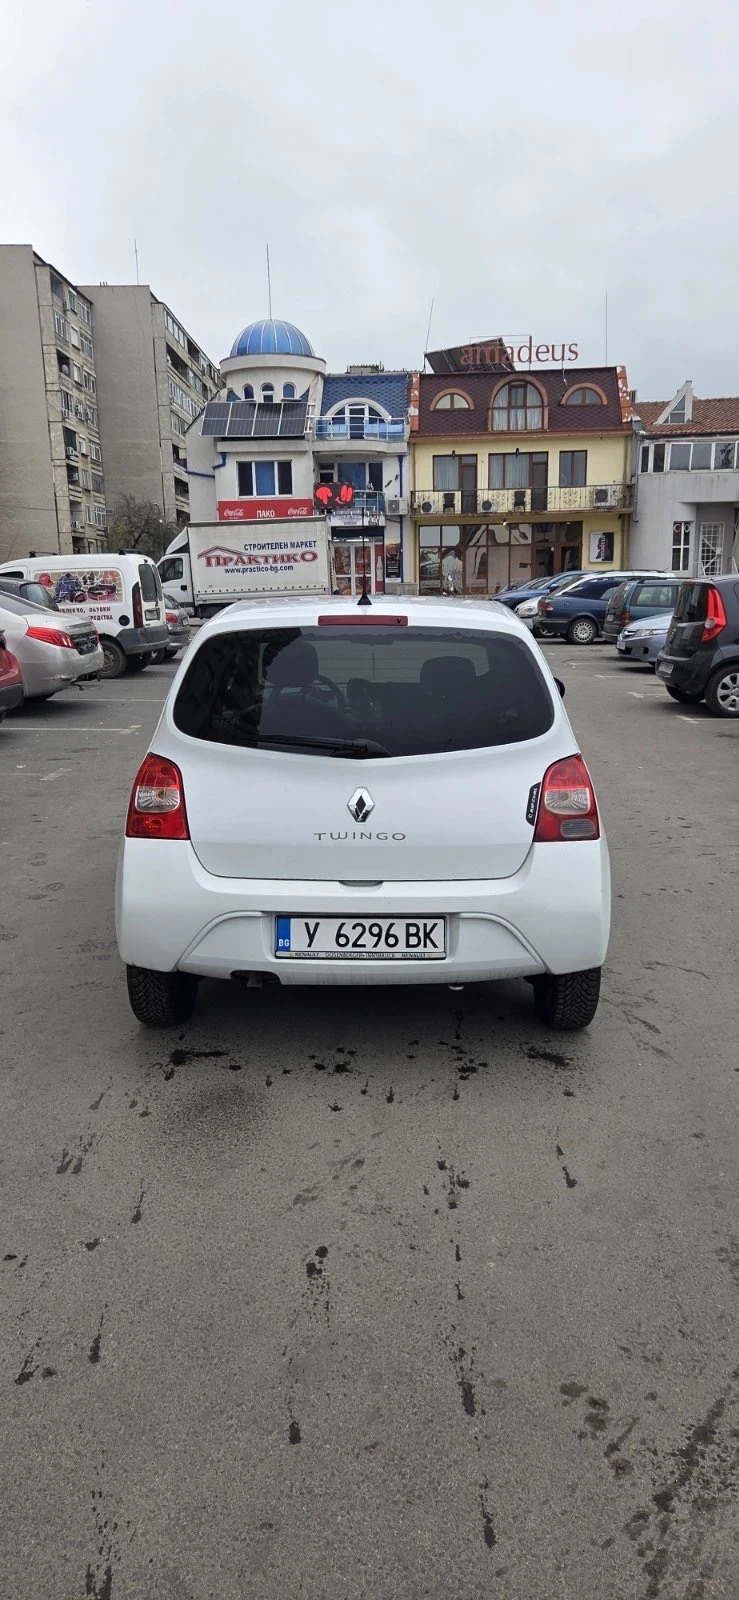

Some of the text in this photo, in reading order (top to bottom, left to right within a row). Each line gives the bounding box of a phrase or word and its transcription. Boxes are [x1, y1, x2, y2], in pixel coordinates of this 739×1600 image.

[460, 335, 579, 366] amadeus
[224, 508, 244, 517] Coca-Cola
[256, 510, 275, 518] ПАКО
[287, 507, 308, 516] Coca-Cola
[243, 540, 317, 551] СТРОИТЕЛЕН МАРКЕТ
[224, 564, 294, 575] www.practico-bg.com
[313, 831, 406, 841] TWINGO
[334, 922, 399, 948] 6296
[278, 939, 290, 948] BG
